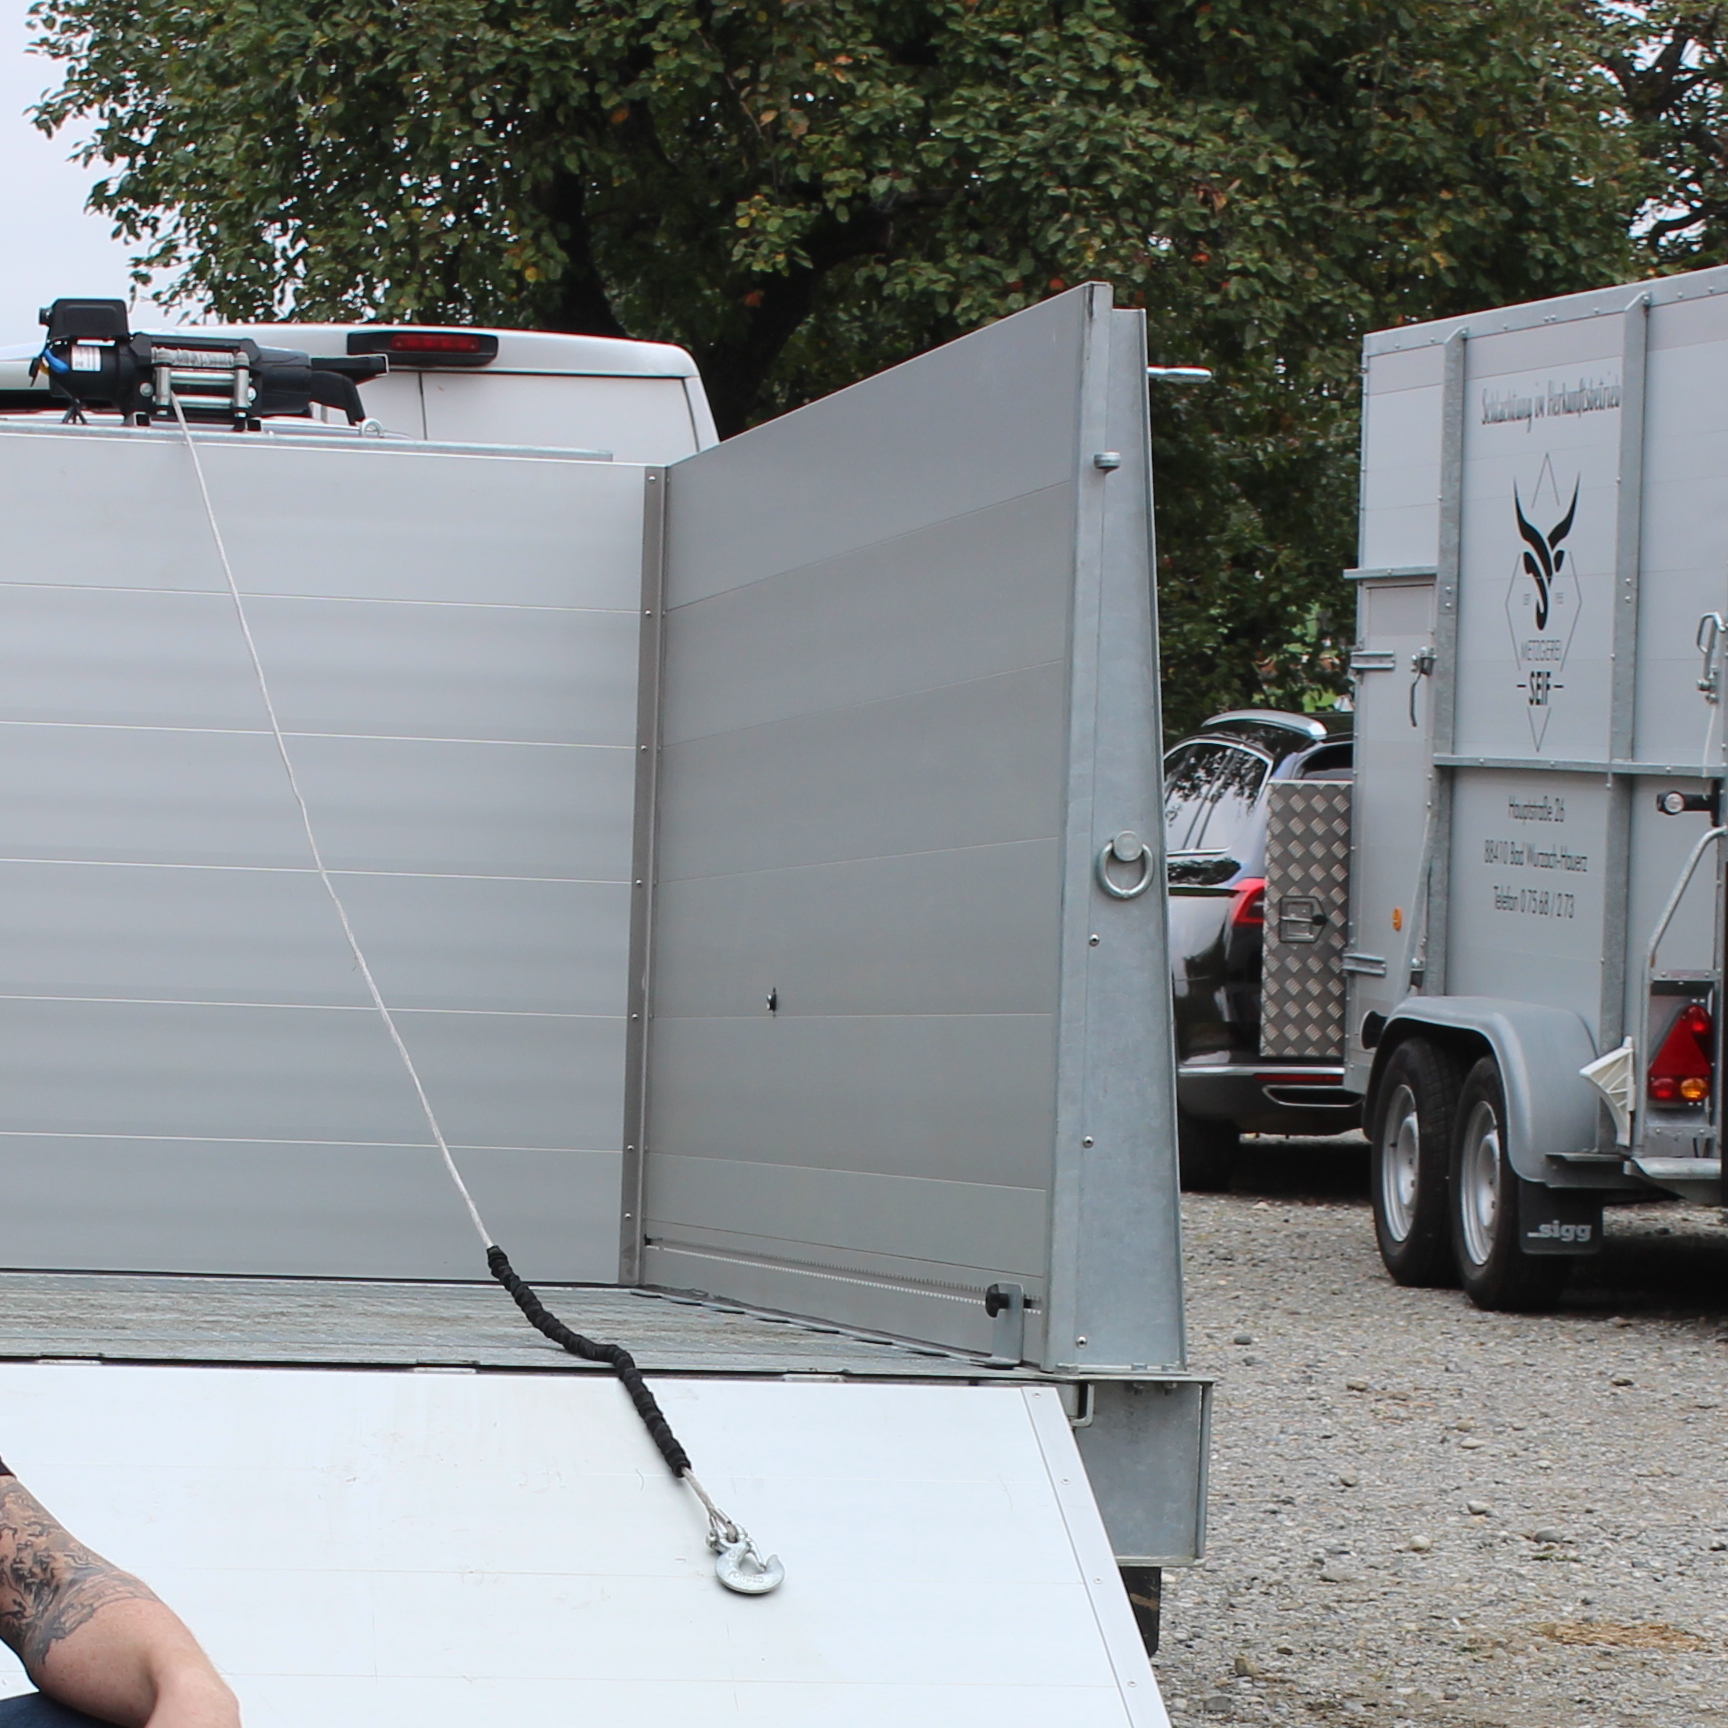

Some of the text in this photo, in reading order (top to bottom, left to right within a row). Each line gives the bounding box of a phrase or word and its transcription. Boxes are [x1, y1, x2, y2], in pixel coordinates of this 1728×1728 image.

[1529, 670, 1551, 706] SEIF
[1508, 795, 1564, 825] Hauptstraße 26
[1510, 841, 1524, 866] Bad
[1493, 885, 1518, 911] Telefon
